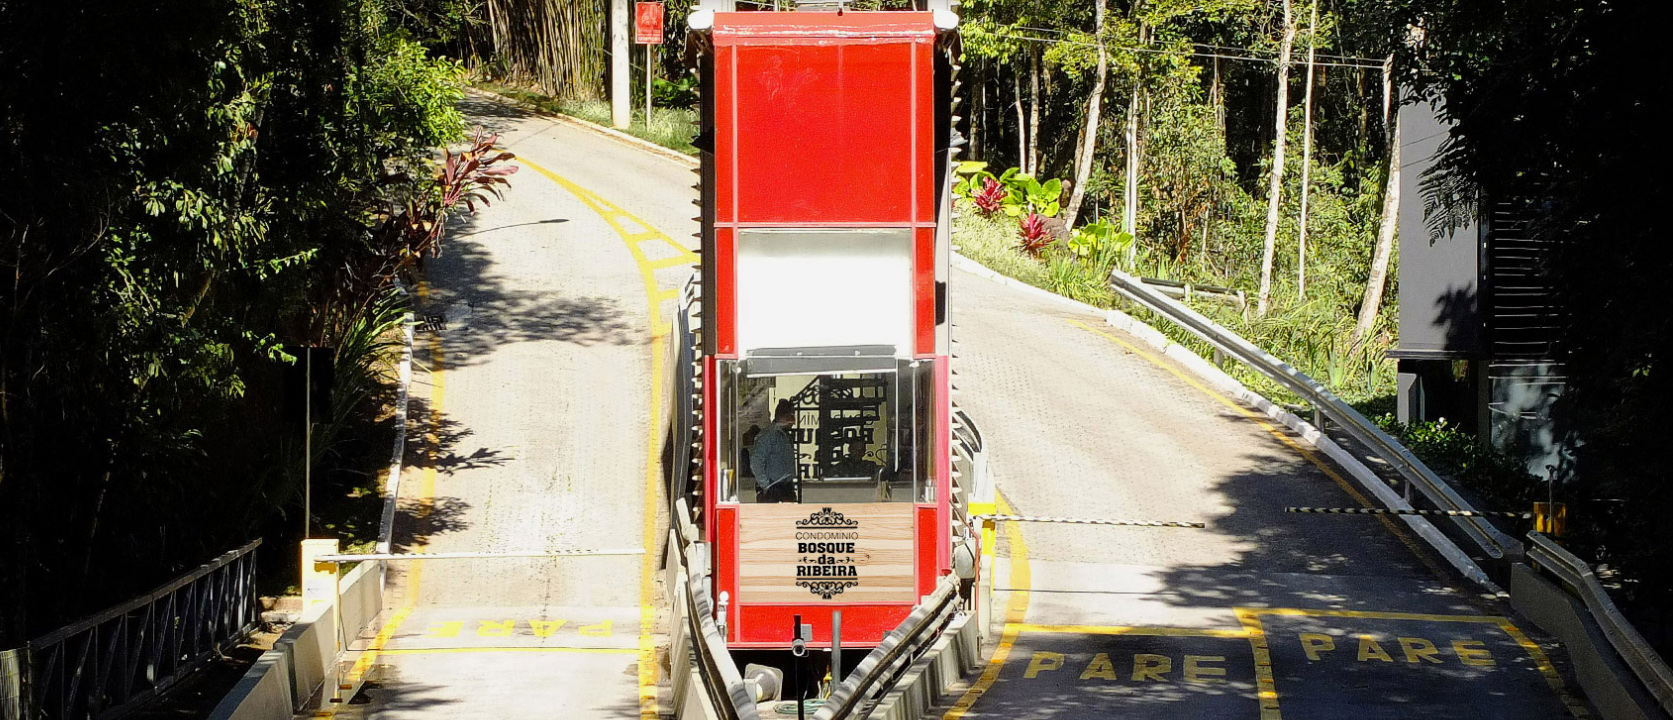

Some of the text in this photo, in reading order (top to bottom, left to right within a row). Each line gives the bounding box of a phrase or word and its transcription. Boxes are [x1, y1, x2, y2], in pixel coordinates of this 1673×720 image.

[798, 542, 855, 554] BOSQUE
[818, 554, 835, 564] da
[796, 565, 857, 576] RIBEIRA
[422, 620, 613, 638] PARE
[1301, 633, 1497, 666] PARE
[1023, 651, 1227, 683] PARE
